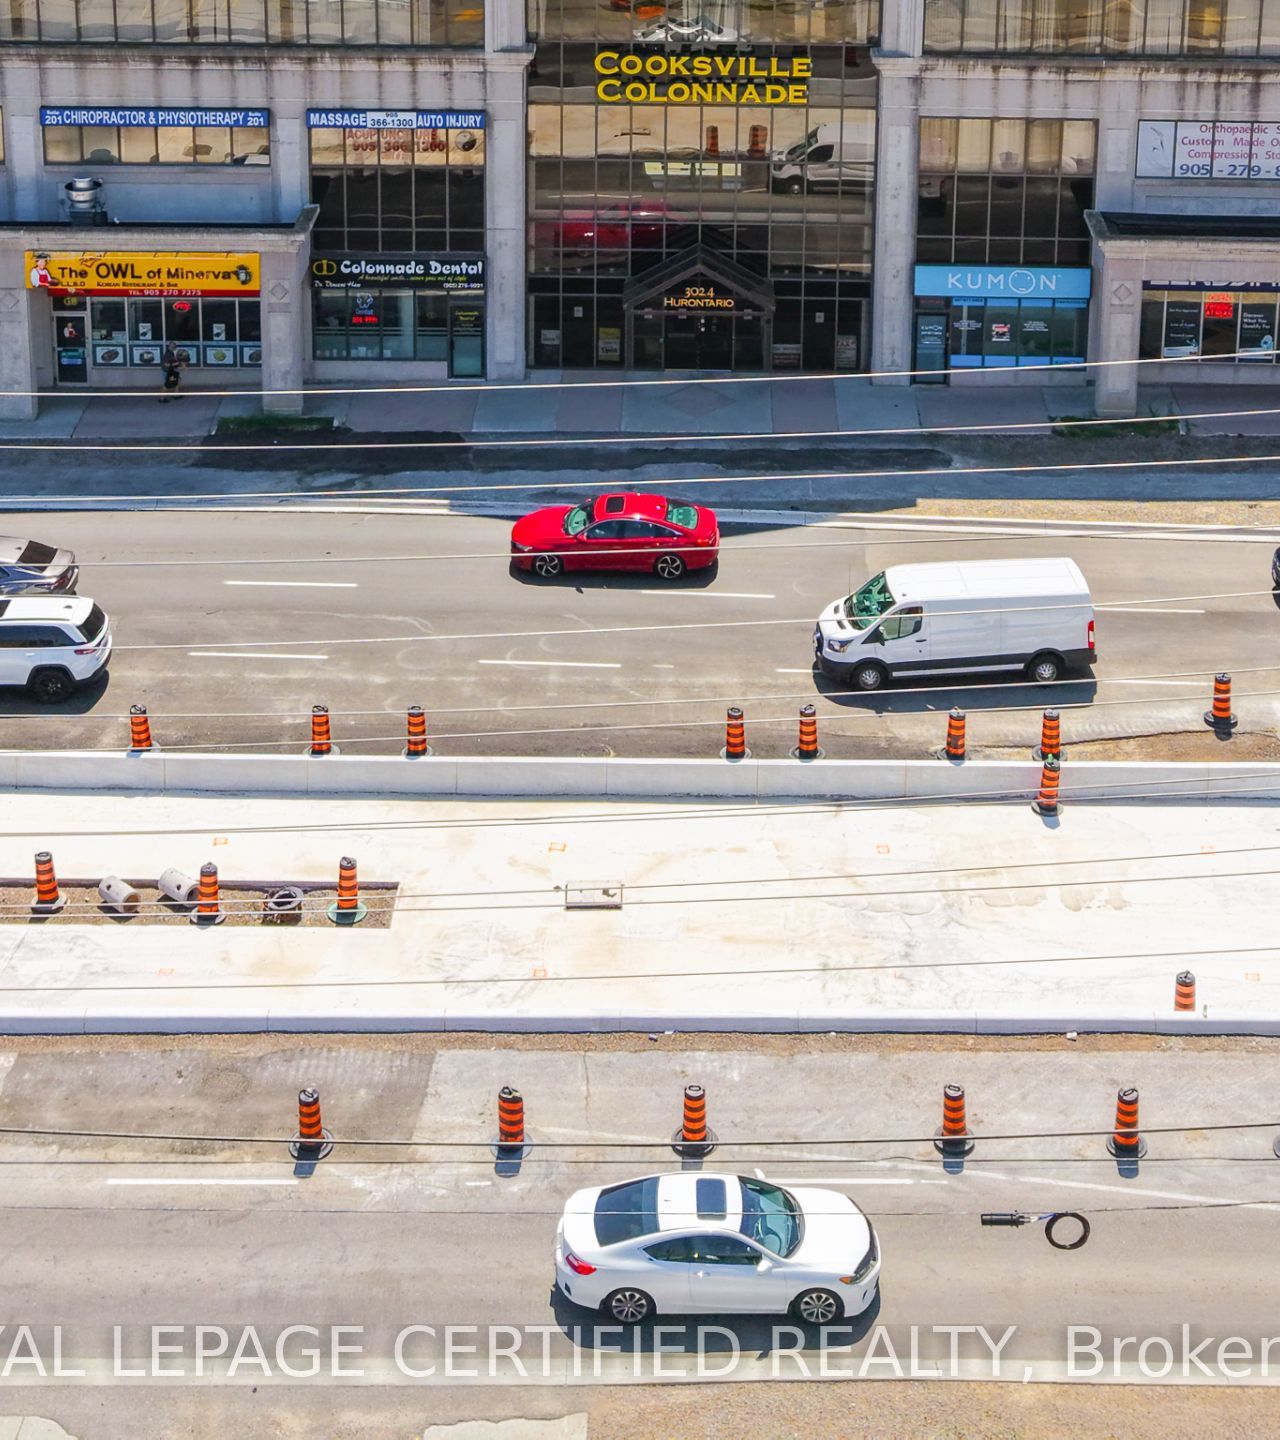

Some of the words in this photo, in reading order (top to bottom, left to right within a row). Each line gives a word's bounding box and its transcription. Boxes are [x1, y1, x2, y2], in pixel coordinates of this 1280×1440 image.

[594, 51, 812, 77] COOKSVILLE
[597, 79, 808, 104] COLONNADE
[45, 116, 62, 124] 201
[63, 111, 146, 124] CHIROPRACTOR
[148, 112, 156, 124] &
[158, 112, 244, 125] PHYSIOTHERAPY
[247, 117, 264, 126] 201
[310, 113, 367, 126] MASSAGE
[370, 119, 413, 127] 366-1300
[417, 114, 443, 127] AUTO
[446, 115, 481, 127] INJURY
[1199, 124, 1268, 135] Orthopaedic
[353, 141, 376, 151] 905
[384, 141, 408, 152] 366
[1181, 136, 1224, 146] Custom
[1233, 137, 1265, 147] Made
[1188, 149, 1258, 161] Compression
[1180, 164, 1210, 175] 905
[1228, 164, 1261, 176] 279
[58, 267, 88, 279] The
[96, 263, 142, 279] OWL
[147, 267, 161, 279] of
[167, 268, 231, 280] Minerva
[340, 260, 424, 274] Colonnade
[429, 261, 483, 275] Dental
[948, 270, 1057, 294] KUMON
[685, 286, 715, 298] 3024
[664, 297, 735, 307] HURONTARIO
